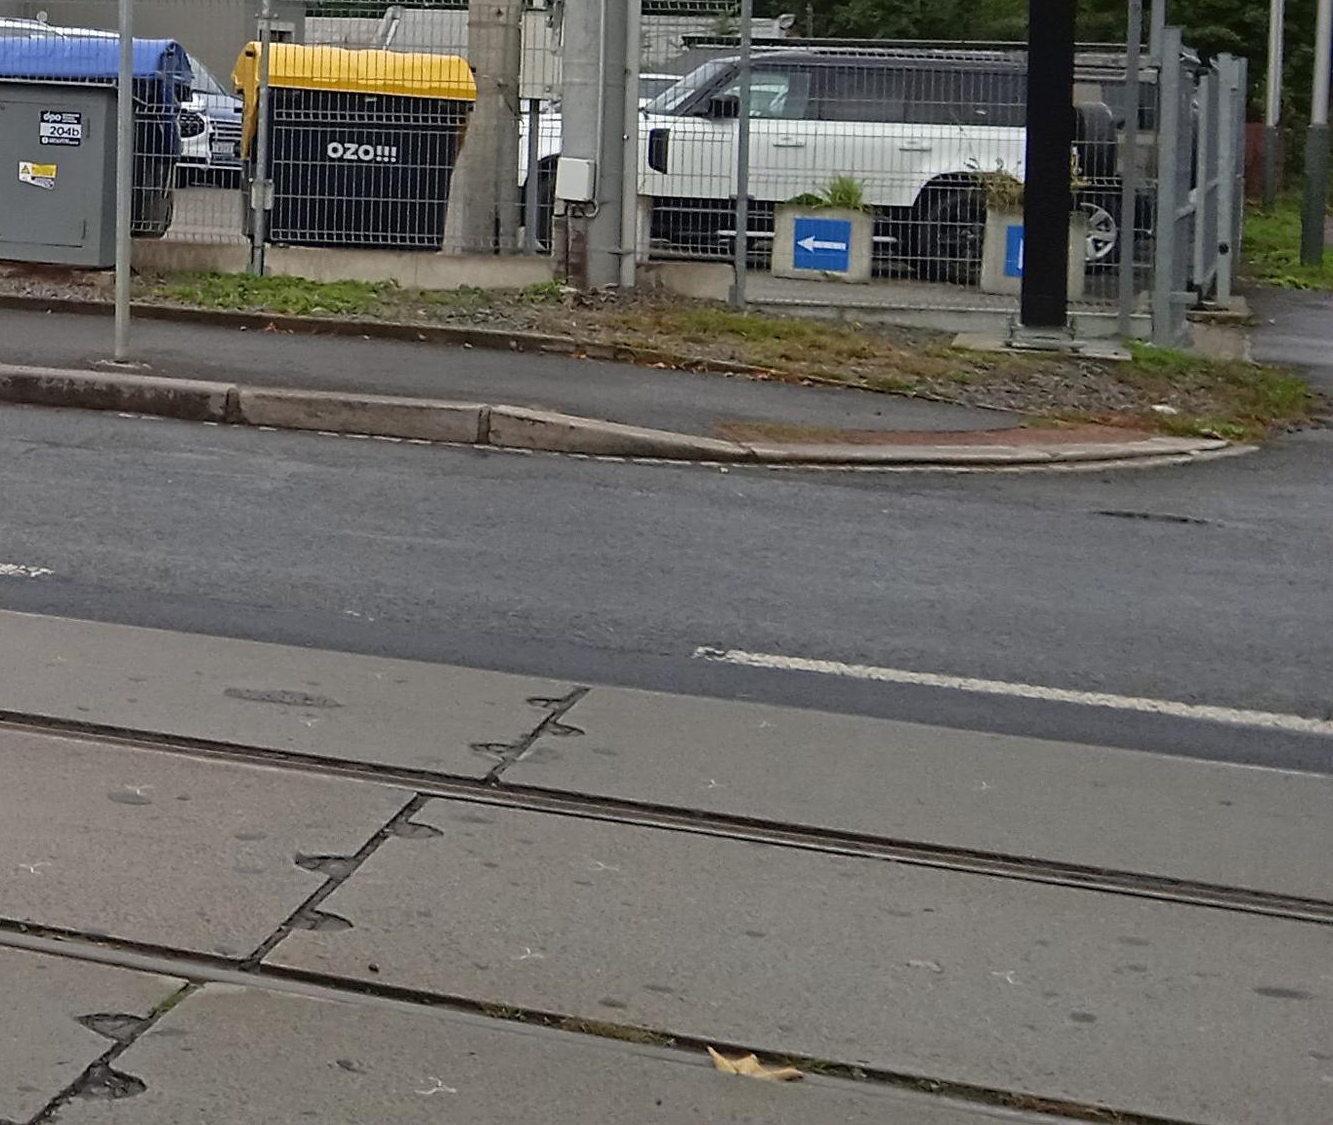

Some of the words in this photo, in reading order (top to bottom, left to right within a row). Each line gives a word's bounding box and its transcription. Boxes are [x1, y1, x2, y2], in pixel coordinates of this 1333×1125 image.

[42, 112, 62, 123] dpo
[49, 125, 80, 137] 204b
[327, 141, 397, 163] OZO!!!
